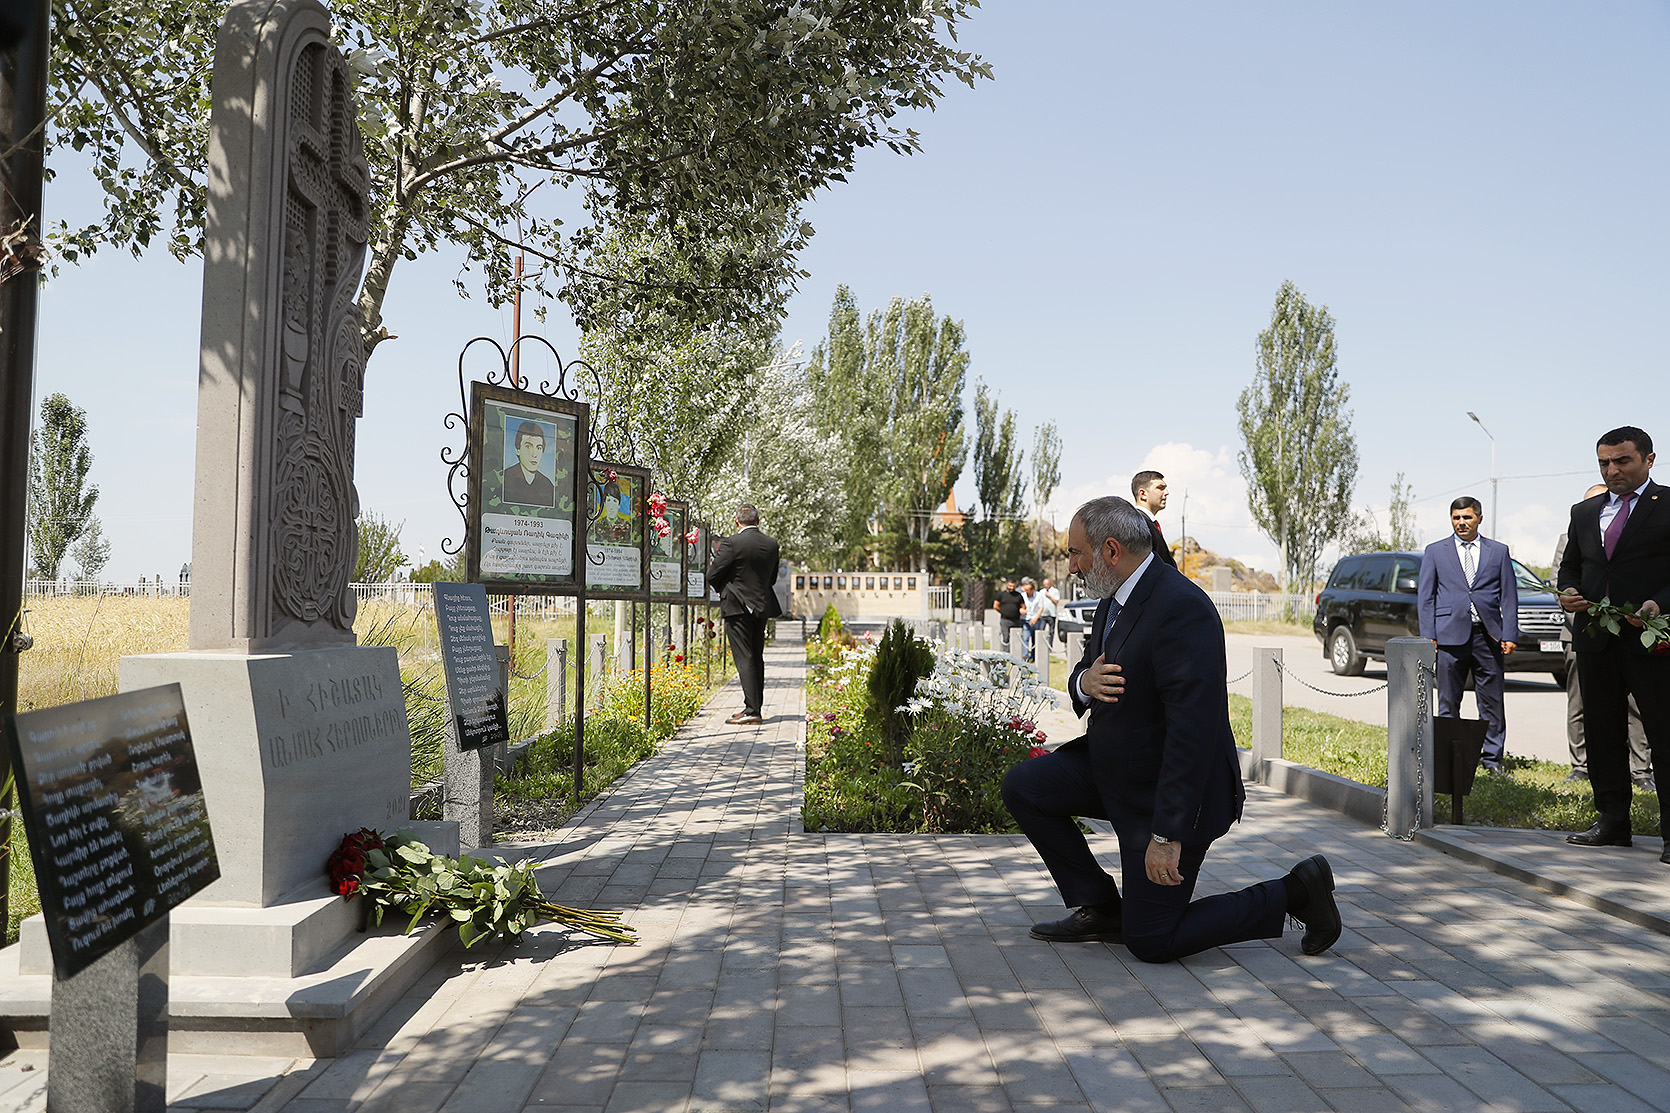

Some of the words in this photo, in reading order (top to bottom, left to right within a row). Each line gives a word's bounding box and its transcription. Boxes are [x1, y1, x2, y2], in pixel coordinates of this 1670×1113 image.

[514, 520, 543, 528] 1974-1993
[278, 689, 290, 718] Ի
[307, 675, 383, 712] ՀԻՇԱՏԱԿ
[269, 727, 324, 768] ԱՆՄԱՀ
[327, 708, 404, 752] ՀԵՐՈՍՆԵՐԻՆ
[386, 796, 406, 819] 2021
[50, 834, 68, 847] Նոր
[64, 892, 86, 909] Բայց
[86, 881, 105, 896] հողը
